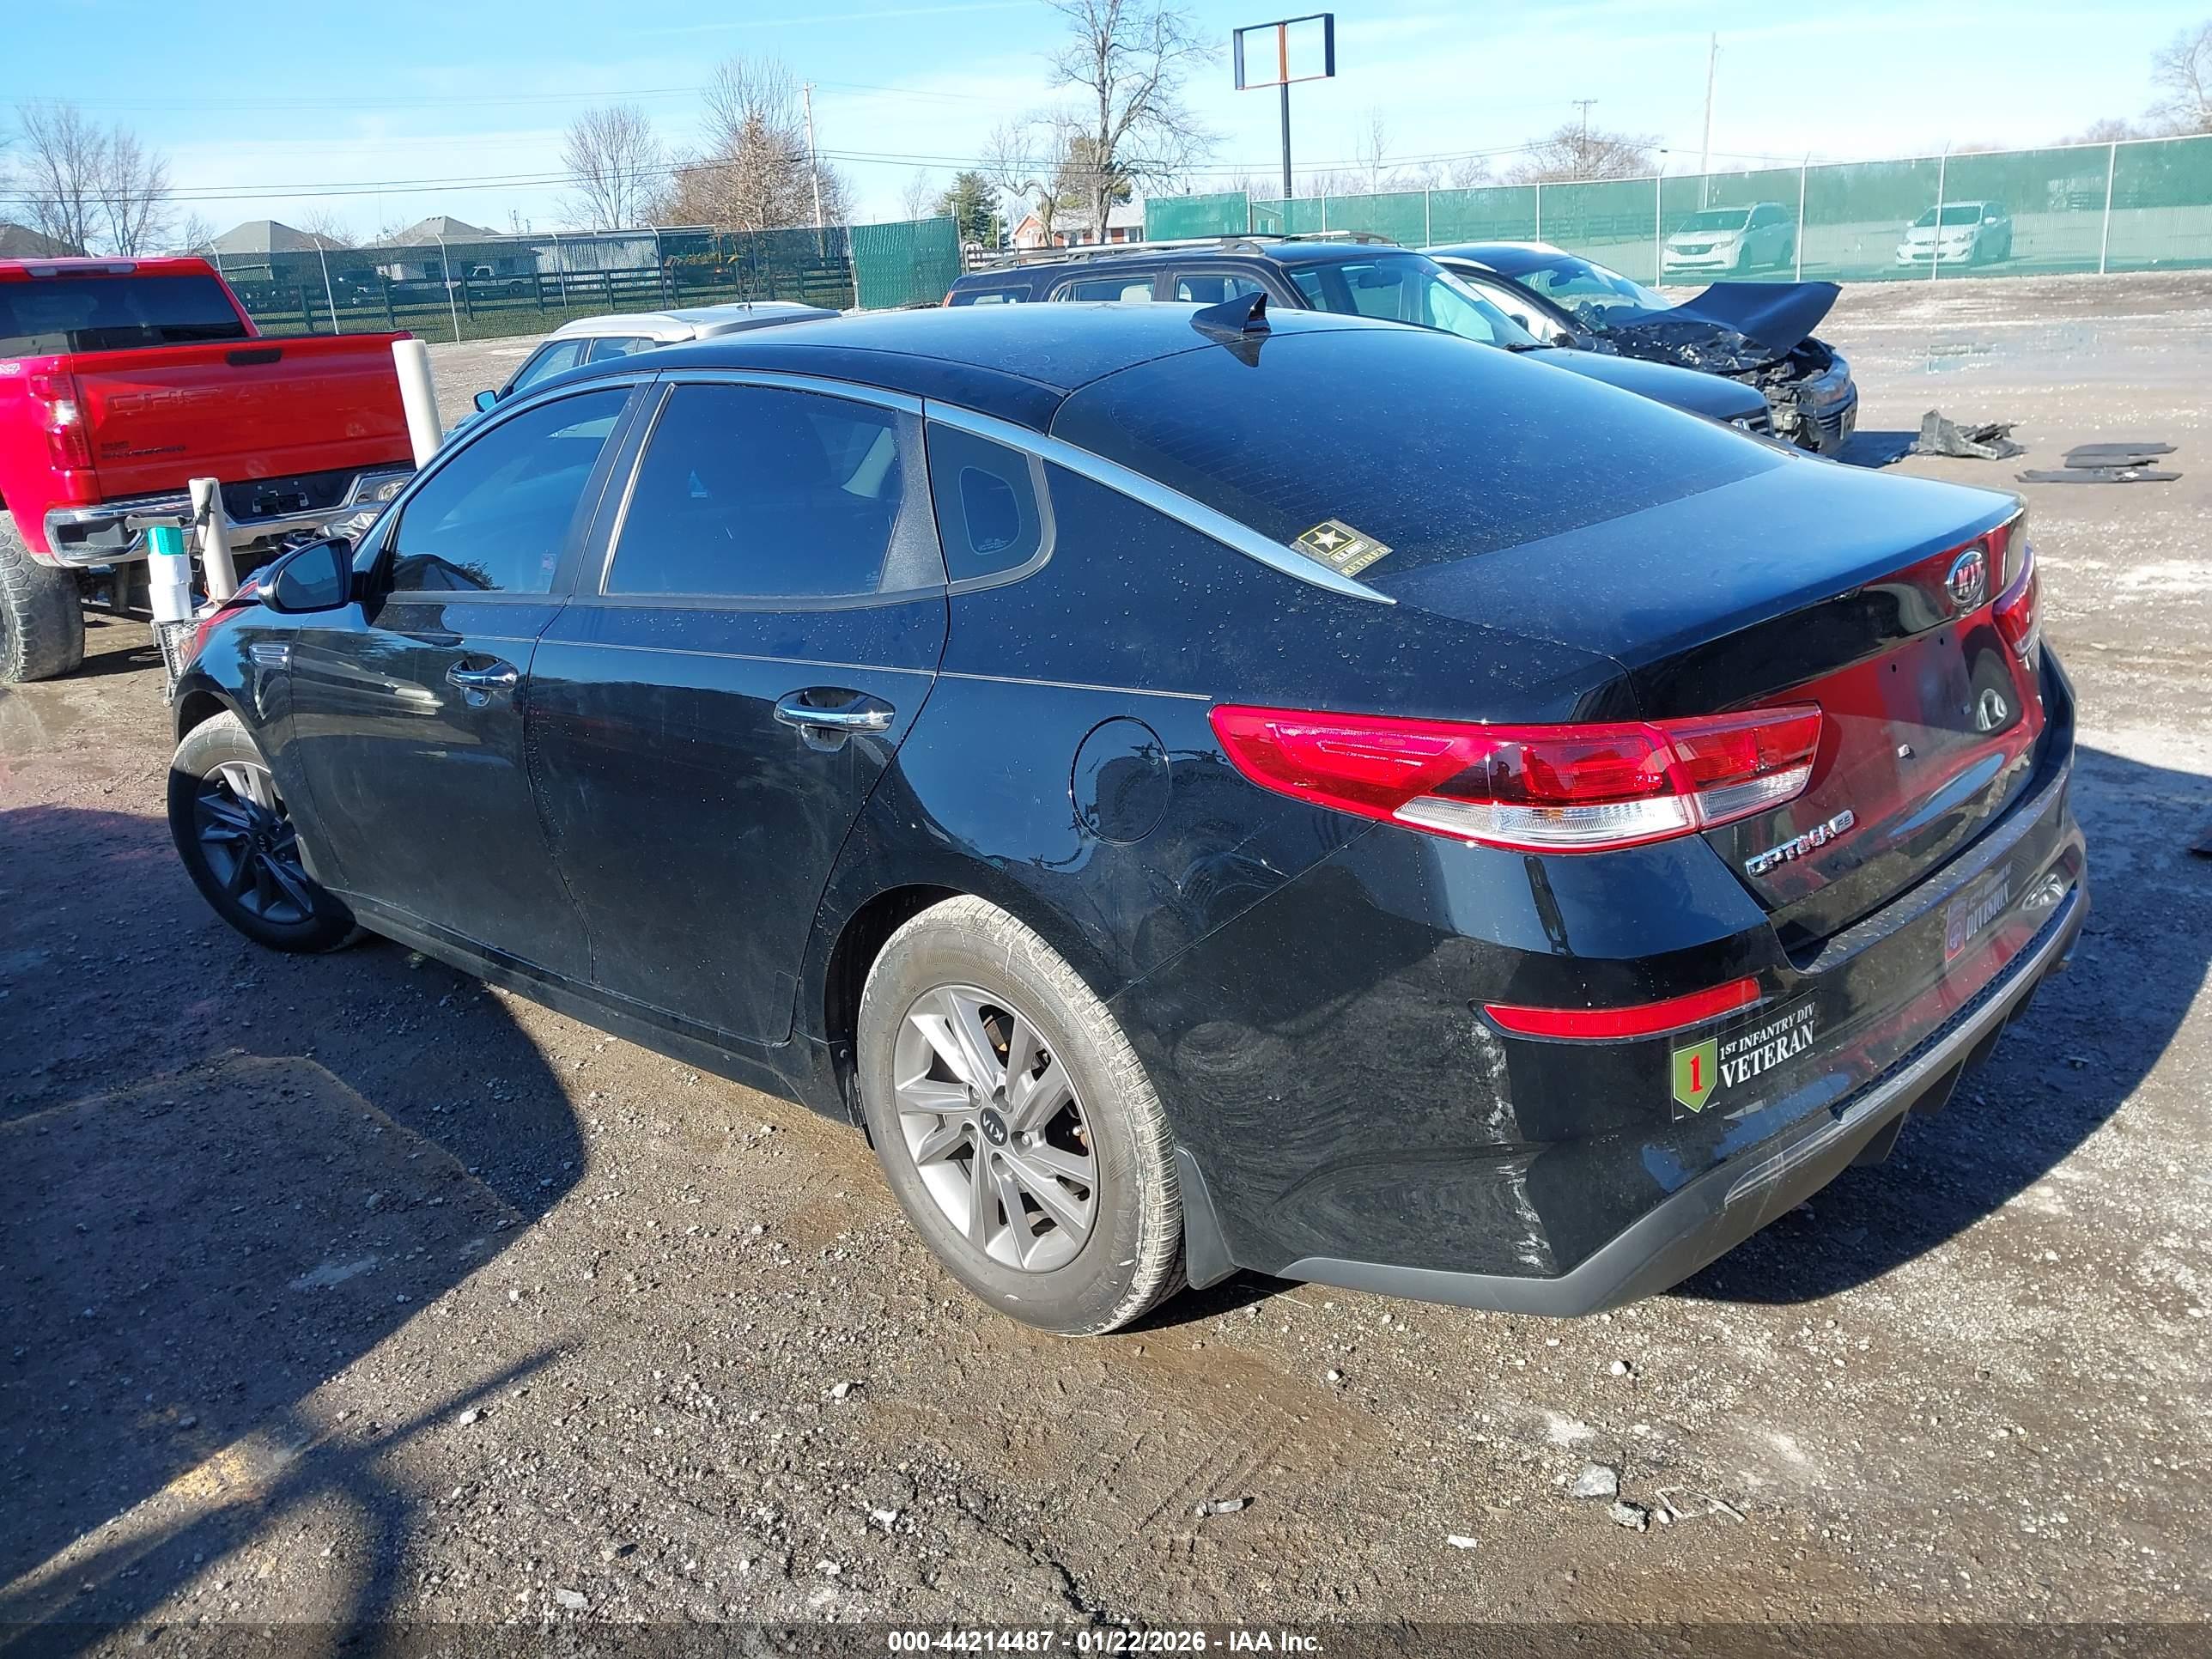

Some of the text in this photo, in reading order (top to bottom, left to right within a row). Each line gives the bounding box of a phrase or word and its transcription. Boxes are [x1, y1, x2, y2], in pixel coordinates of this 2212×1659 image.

[1340, 547, 1389, 576] RETIRED
[1745, 823, 1835, 877] OPTIMA
[1719, 1001, 1816, 1061] 1ST INFANTRY DIV
[1720, 1020, 1815, 1088] VETERAN
[1690, 1054, 1703, 1094] 1
[982, 1112, 1005, 1143] KIA
